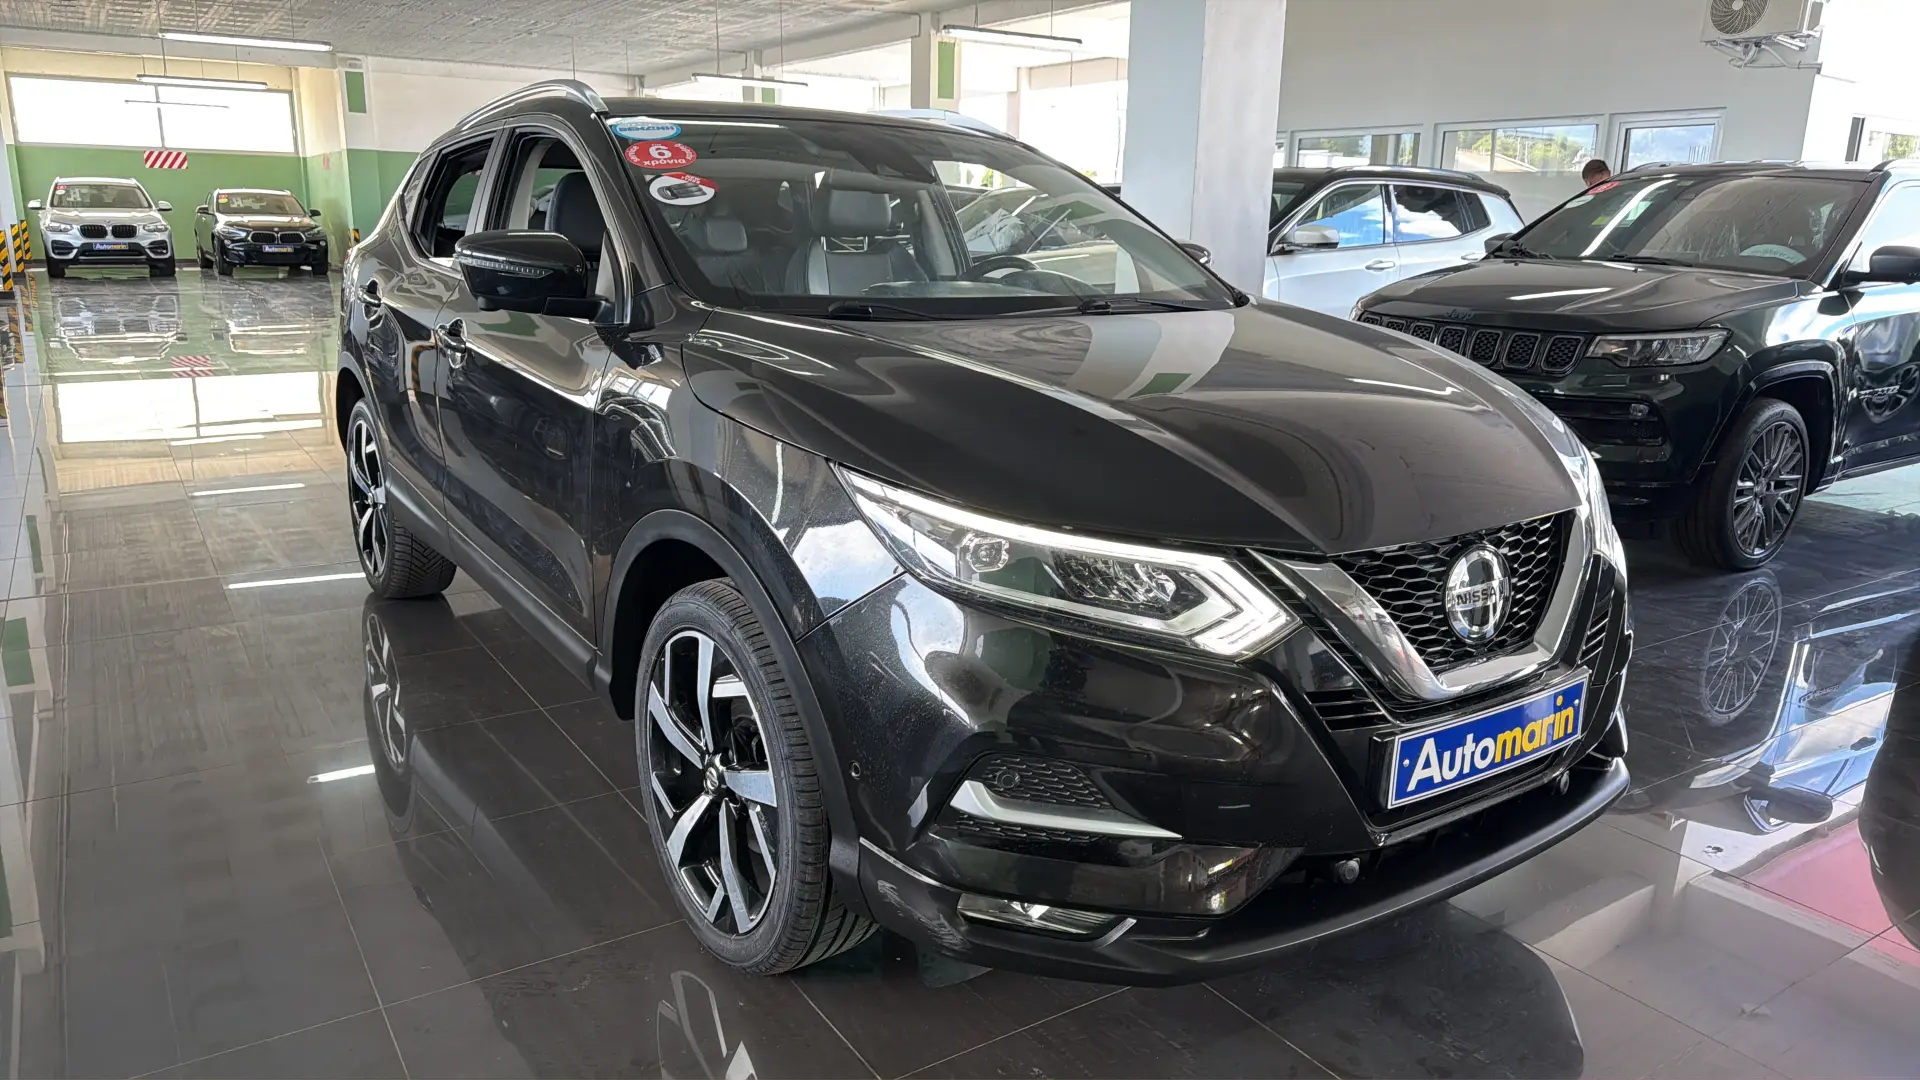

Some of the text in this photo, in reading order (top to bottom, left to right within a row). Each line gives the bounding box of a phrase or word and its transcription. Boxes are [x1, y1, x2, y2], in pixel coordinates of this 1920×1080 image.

[649, 145, 672, 159] 6
[95, 242, 128, 250] Automarin
[1406, 695, 1575, 792] Automarin
